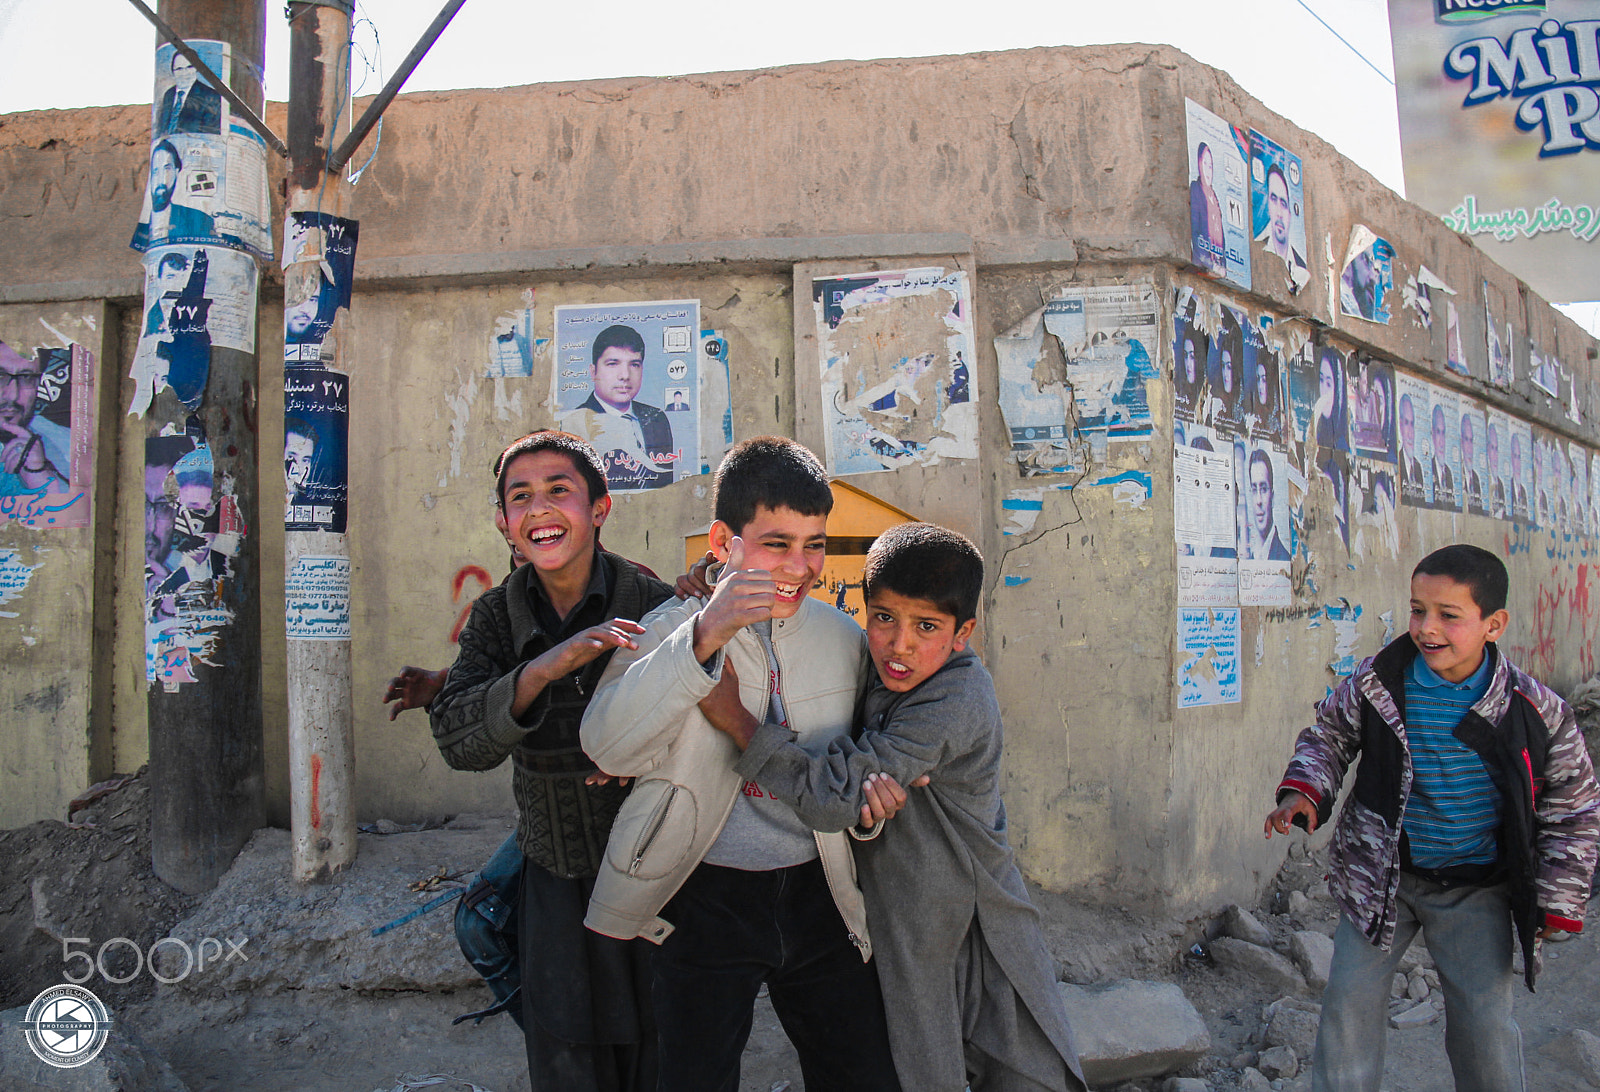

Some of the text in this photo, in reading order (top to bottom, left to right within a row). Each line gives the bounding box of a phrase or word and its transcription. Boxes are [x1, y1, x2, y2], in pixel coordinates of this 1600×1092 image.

[176, 305, 198, 320] ۲۷
[181, 324, 206, 334] انتخاب
[322, 380, 343, 398] ۲۷
[327, 401, 347, 413] انتخاب
[649, 448, 682, 465] احمد
